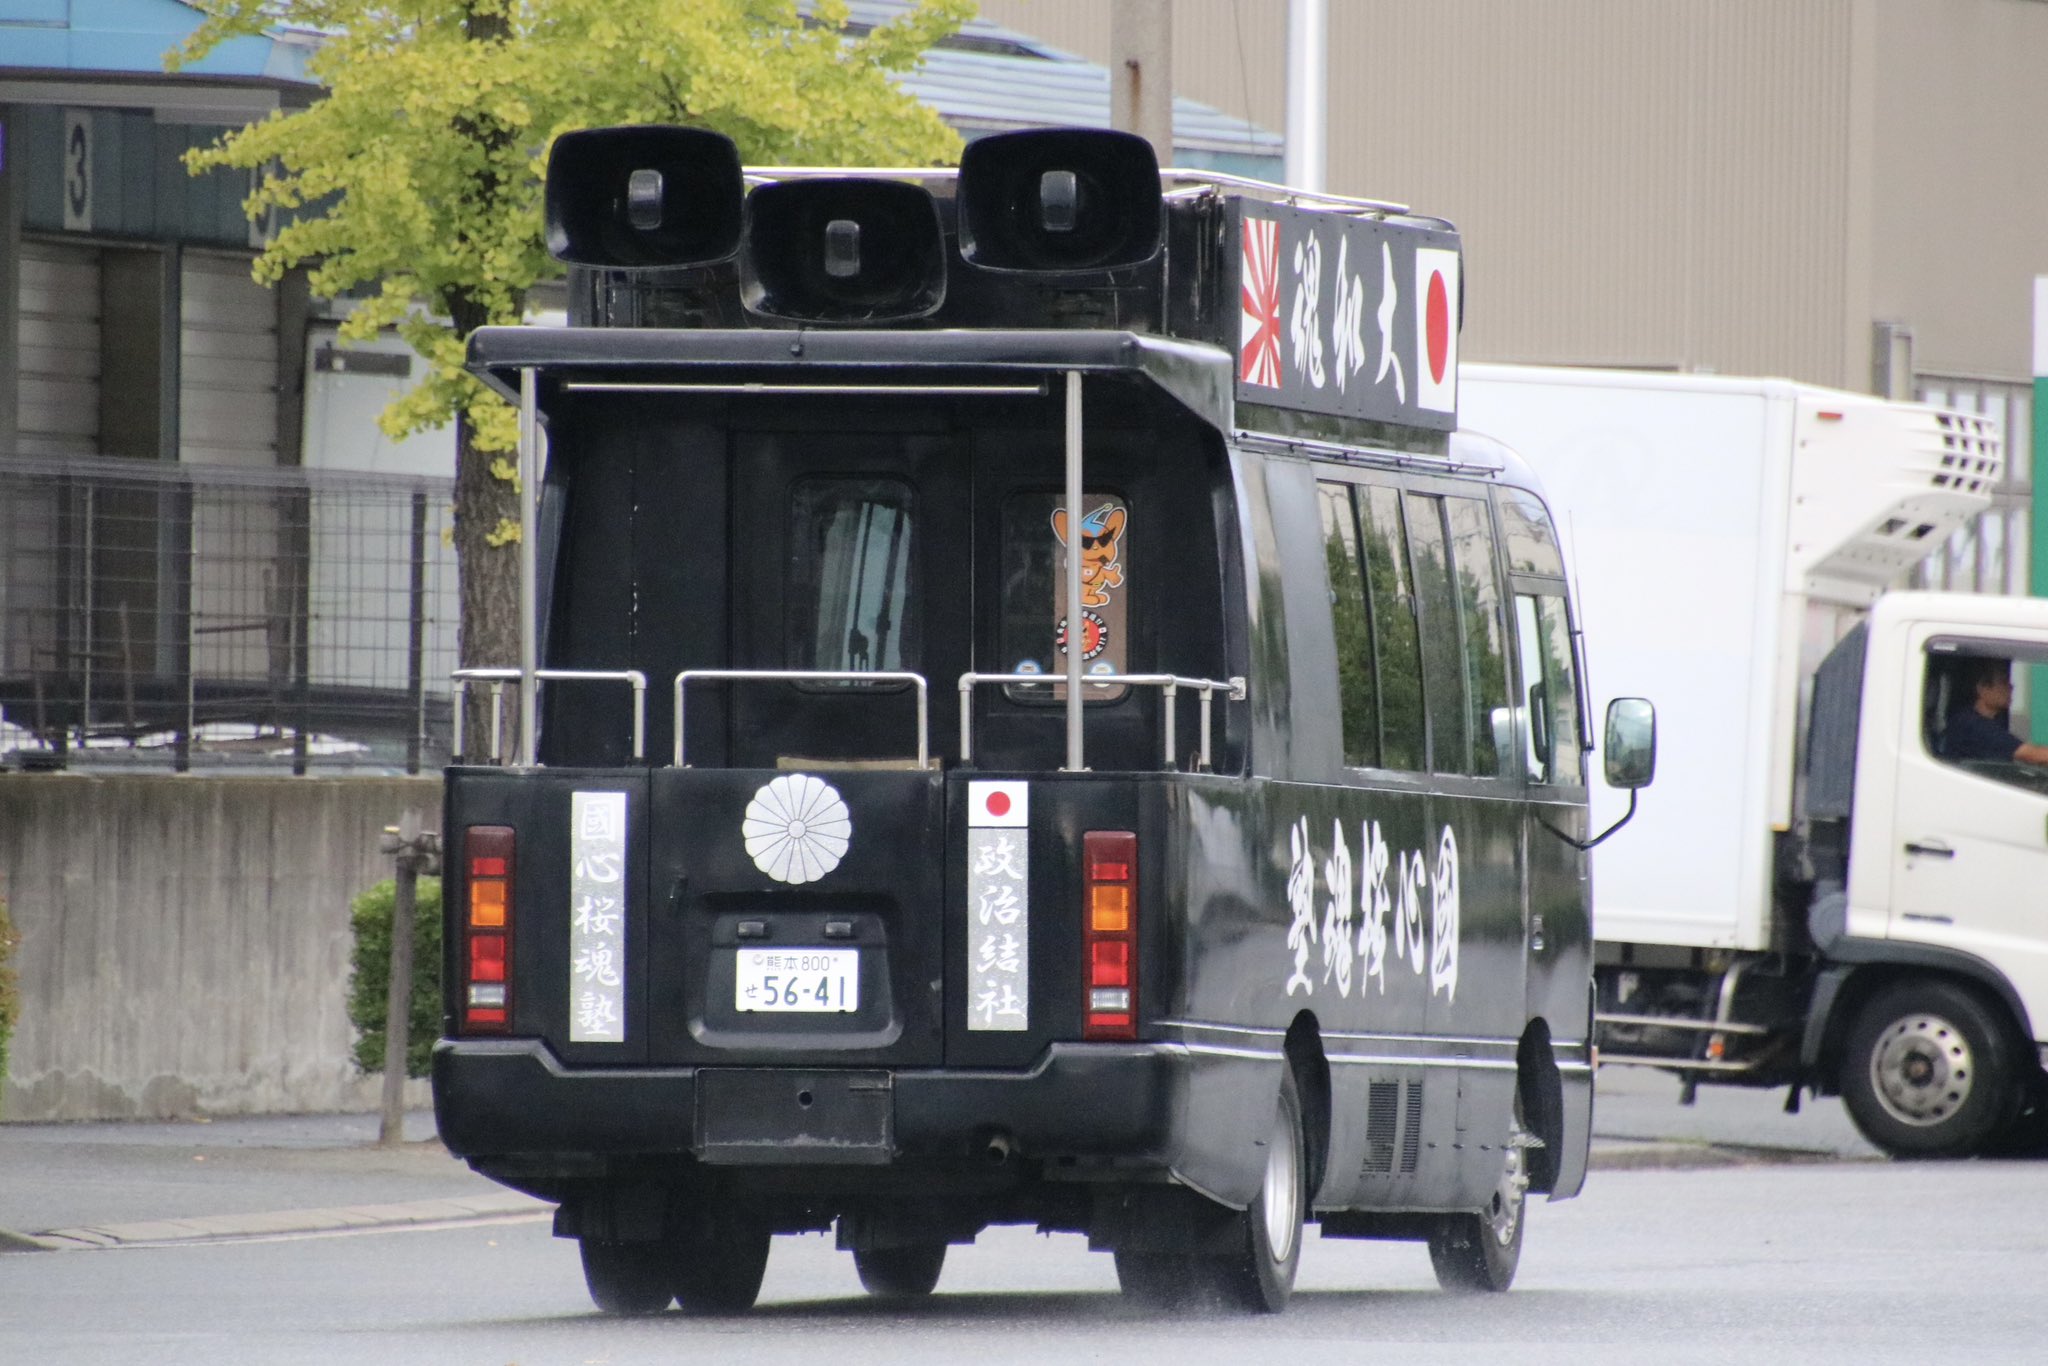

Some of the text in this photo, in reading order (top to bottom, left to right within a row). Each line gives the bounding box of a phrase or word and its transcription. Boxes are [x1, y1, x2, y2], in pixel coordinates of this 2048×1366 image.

[70, 123, 87, 218] 3
[973, 836, 1024, 1024] 政治結社
[744, 976, 845, 1006] せ 56-41
